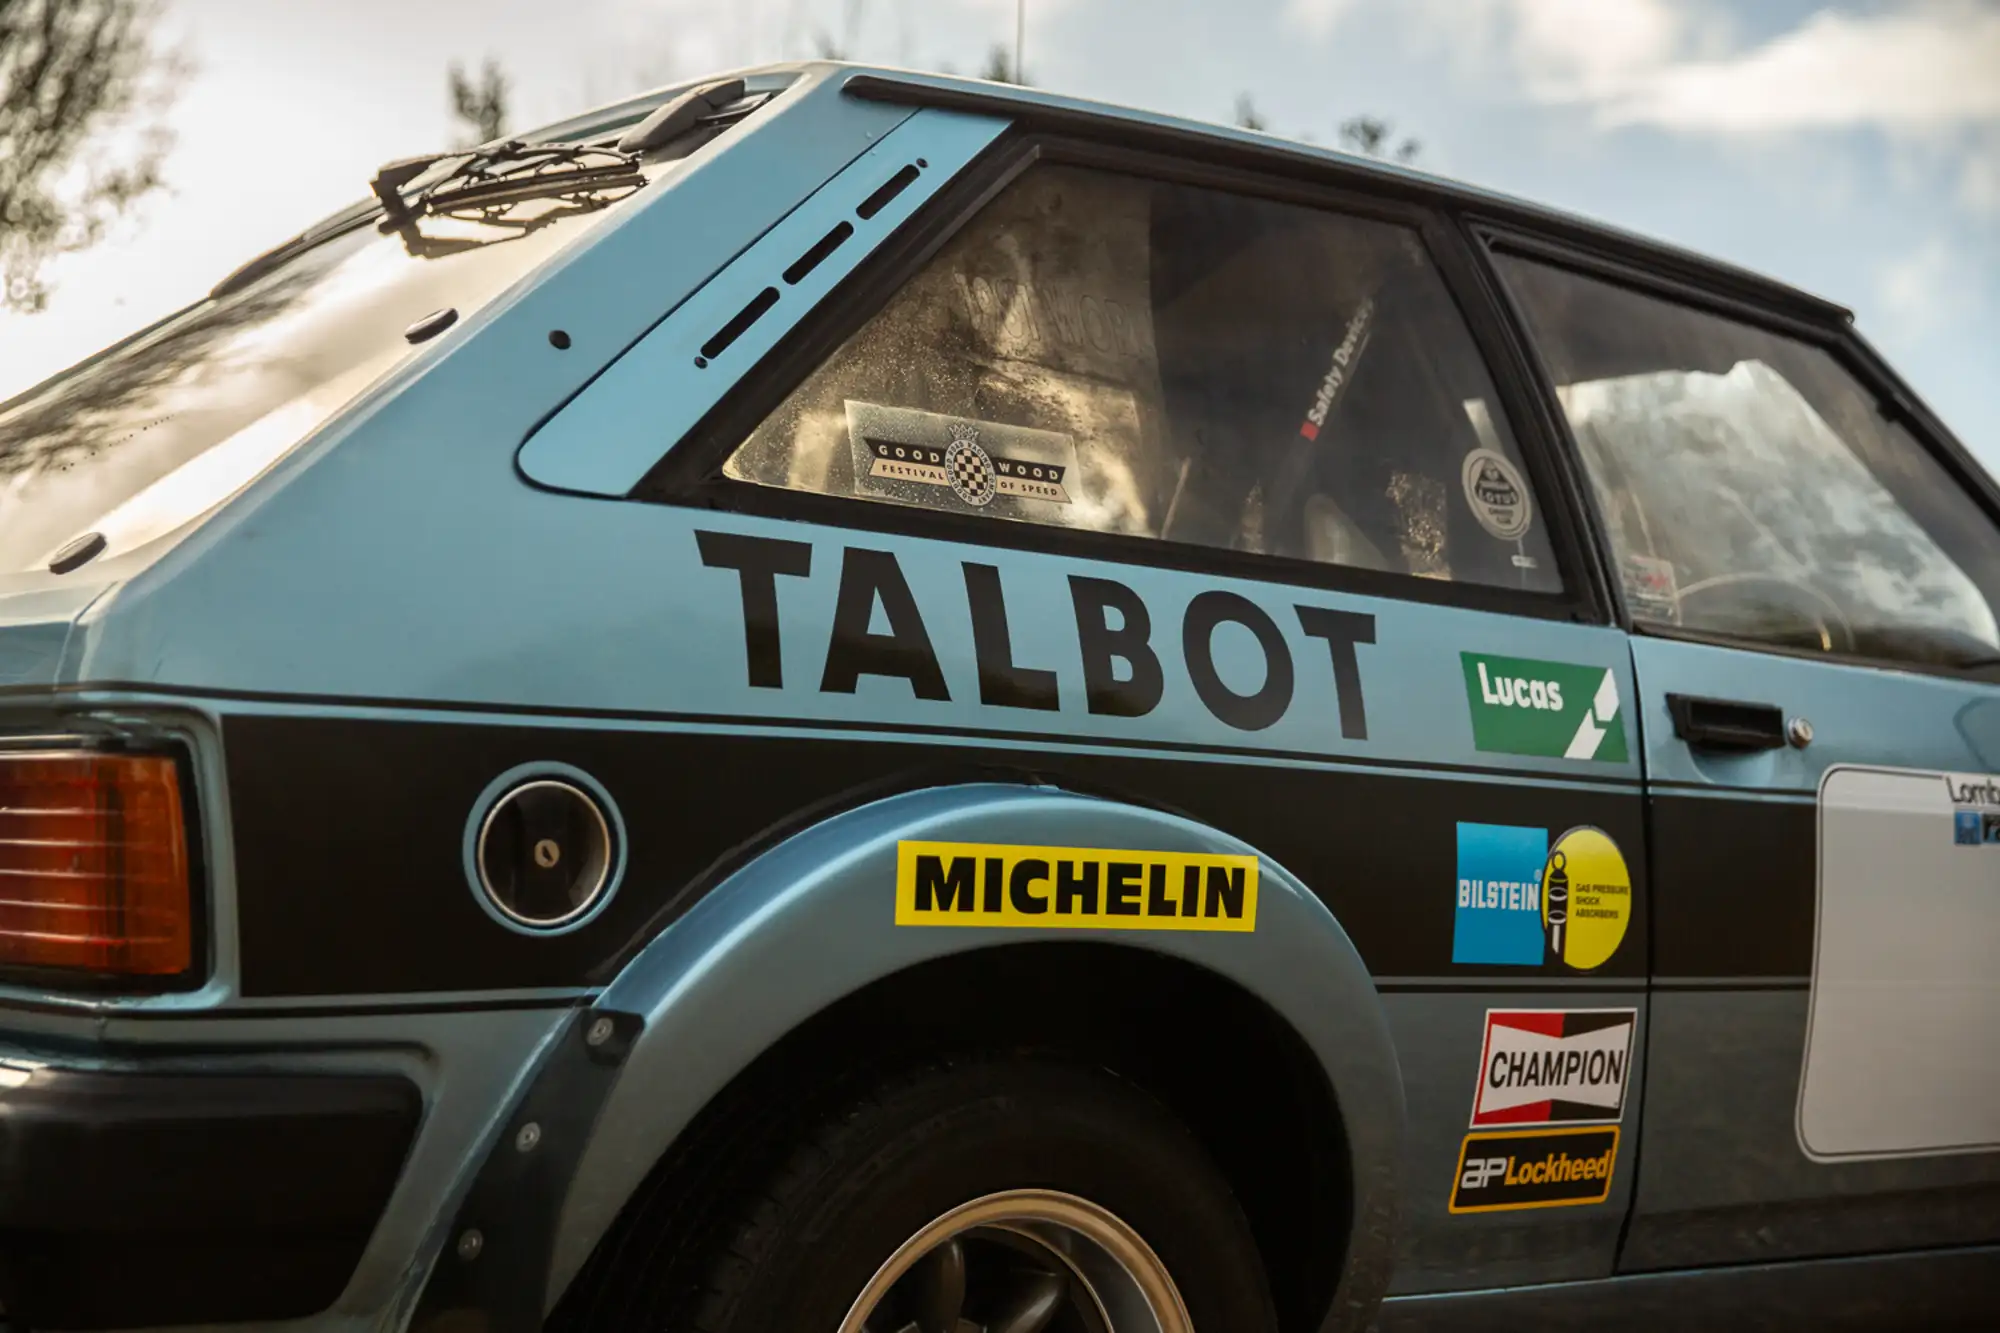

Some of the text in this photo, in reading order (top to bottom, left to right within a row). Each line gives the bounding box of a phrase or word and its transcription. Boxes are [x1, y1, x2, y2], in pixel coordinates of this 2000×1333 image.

[1308, 365, 1343, 427] Safety
[878, 445, 1059, 480] GOOD WOOD
[881, 464, 1058, 496] FESTIVAL OF SPEED
[694, 529, 1376, 740] TALBOT
[1477, 662, 1564, 711] Lucas
[914, 855, 1246, 919] MICHELIN
[1458, 879, 1540, 911] BILSTEIN
[1575, 883, 1629, 896] GAS PRESSURE
[1575, 896, 1600, 906] SHOCK
[1575, 909, 1619, 919] ABSORBERS
[1489, 1049, 1624, 1089] CHAMPION
[1504, 1149, 1613, 1186] Lockheed
